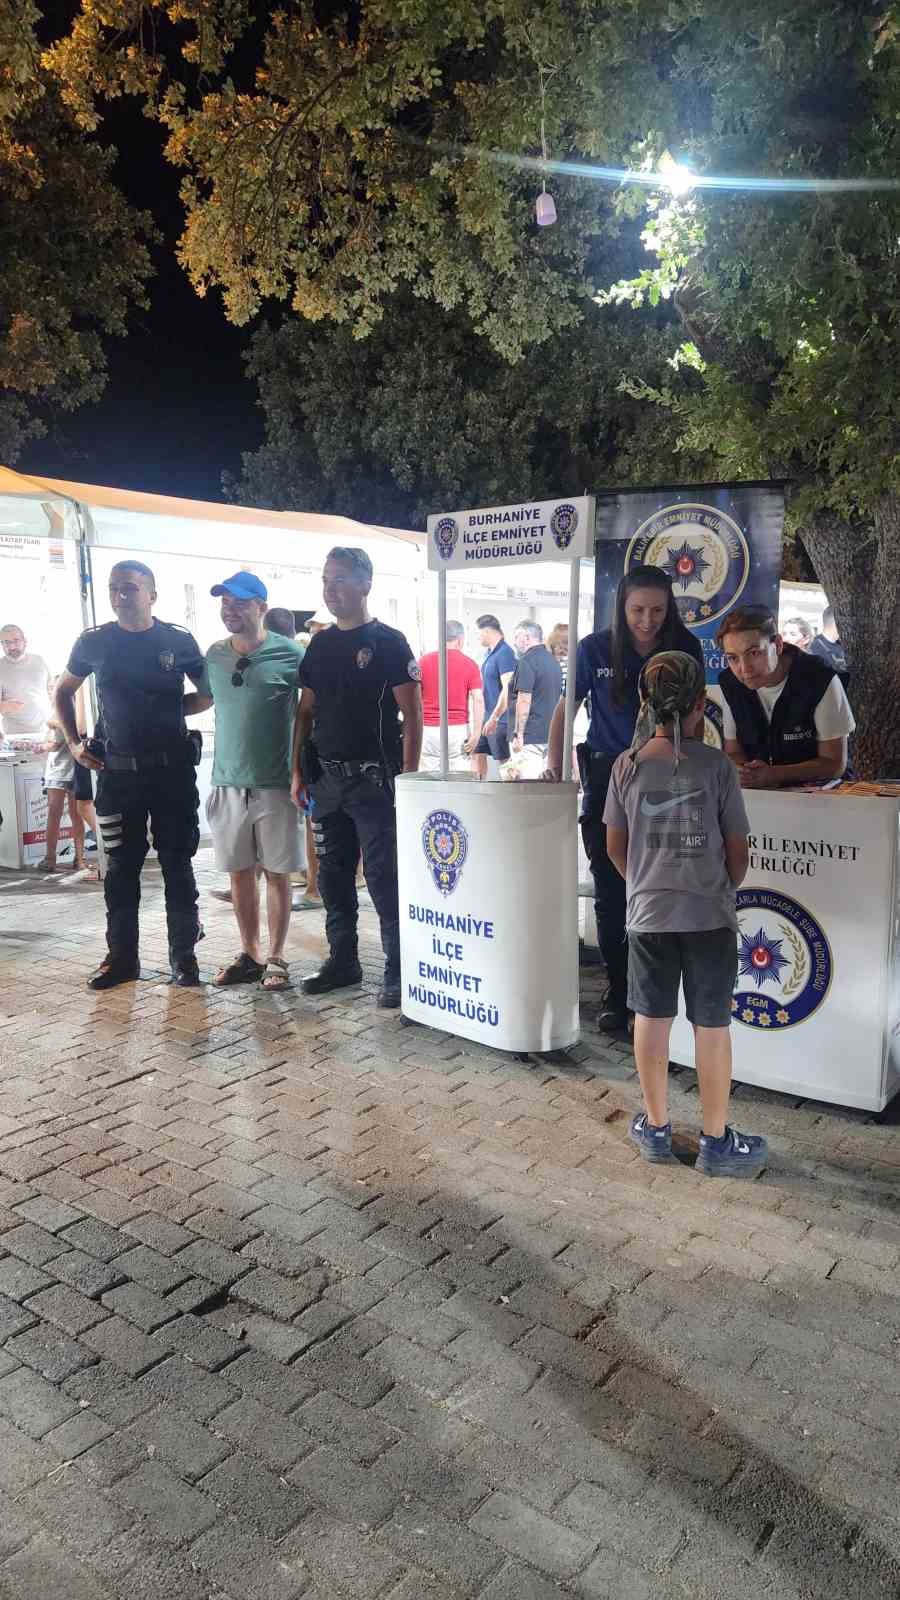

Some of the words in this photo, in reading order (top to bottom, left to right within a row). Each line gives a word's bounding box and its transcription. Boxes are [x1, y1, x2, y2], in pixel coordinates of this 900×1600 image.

[469, 508, 540, 526] BURHANİYE
[463, 530, 487, 544] İLÇE
[491, 525, 546, 541] EMNİYET
[465, 541, 542, 560] MÜDÜRLÜĞÜ
[762, 834, 778, 851] İL
[781, 839, 860, 861] EMNİYET
[749, 852, 816, 876] ÜRLÜĞÜ
[409, 903, 494, 938] BURHANİYE
[432, 933, 464, 961] İLÇE
[418, 960, 482, 994] EMNİYET
[408, 984, 499, 1026] MÜDÜRLÜĞÜ
[746, 996, 769, 1008] EGM
